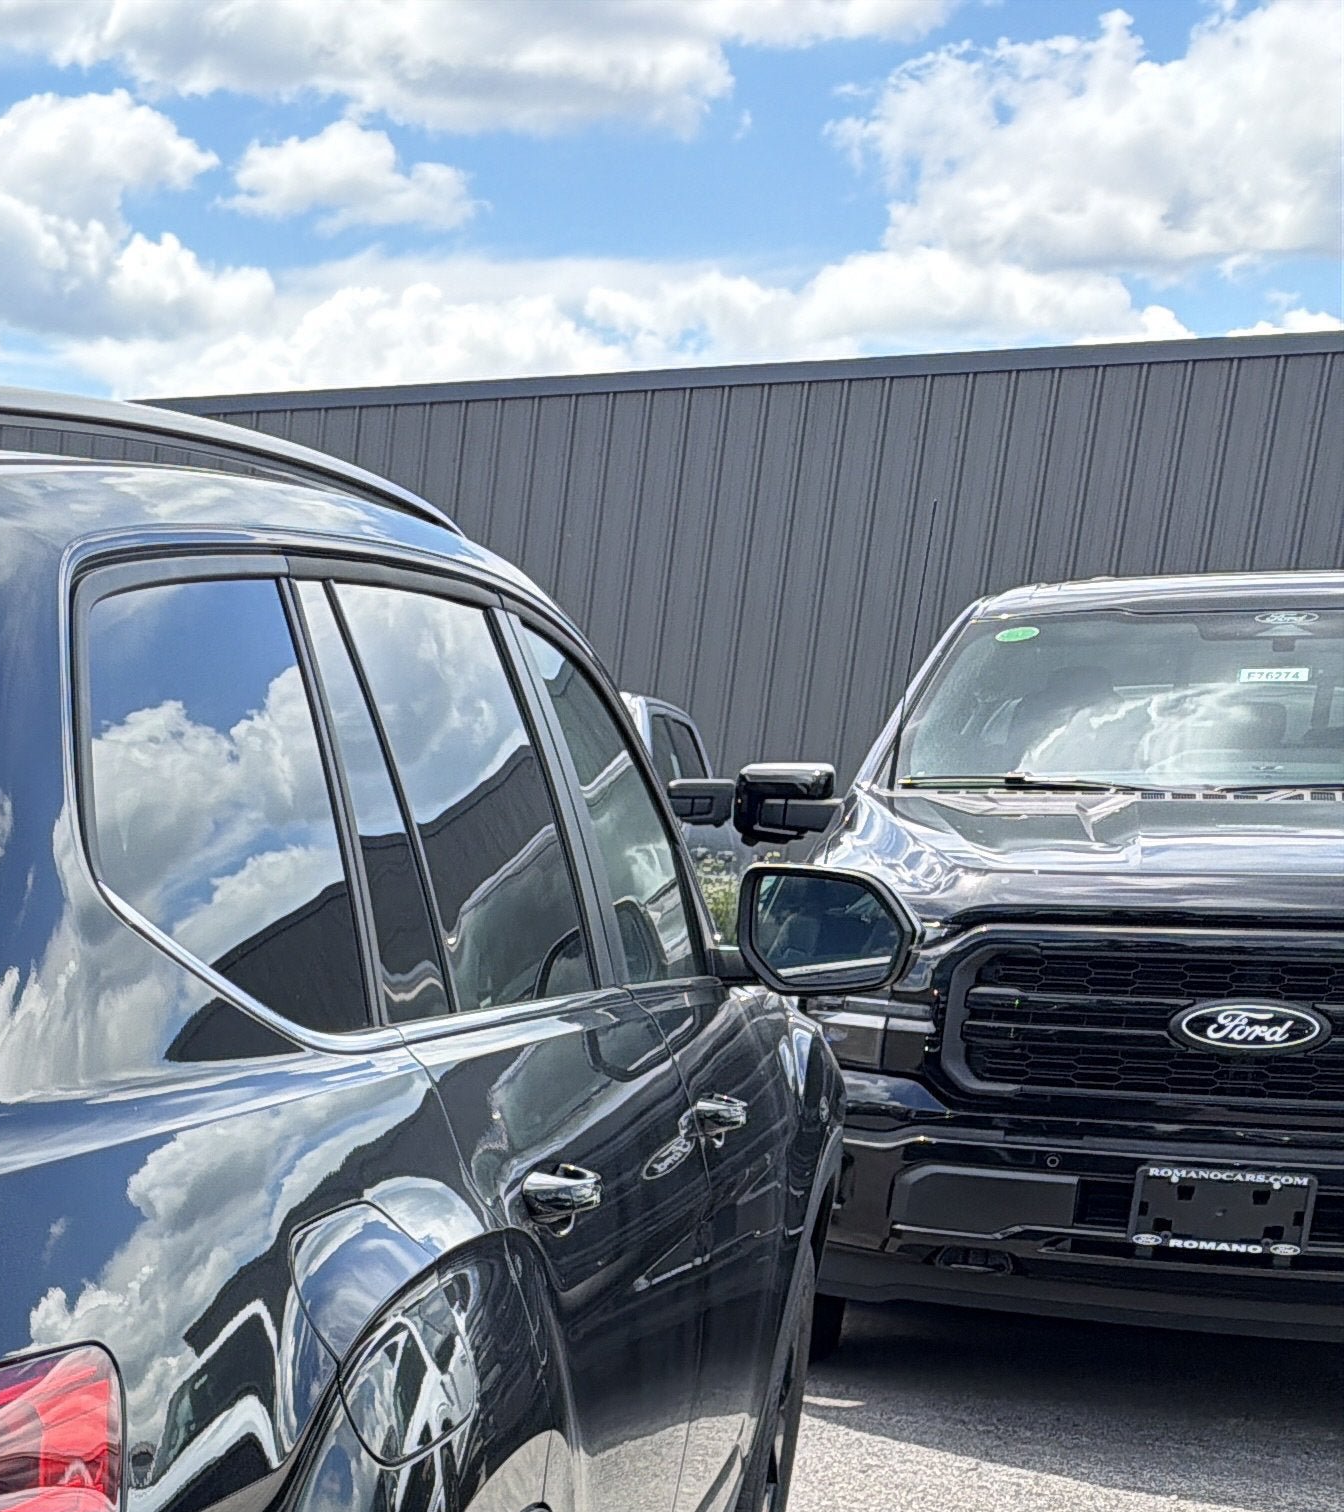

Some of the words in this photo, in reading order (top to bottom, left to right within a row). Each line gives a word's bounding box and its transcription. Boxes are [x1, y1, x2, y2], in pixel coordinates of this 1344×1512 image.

[1207, 1010, 1295, 1042] Ford
[1148, 1167, 1309, 1187] ROMANOCARS.COM
[1168, 1238, 1263, 1254] ROMANO
